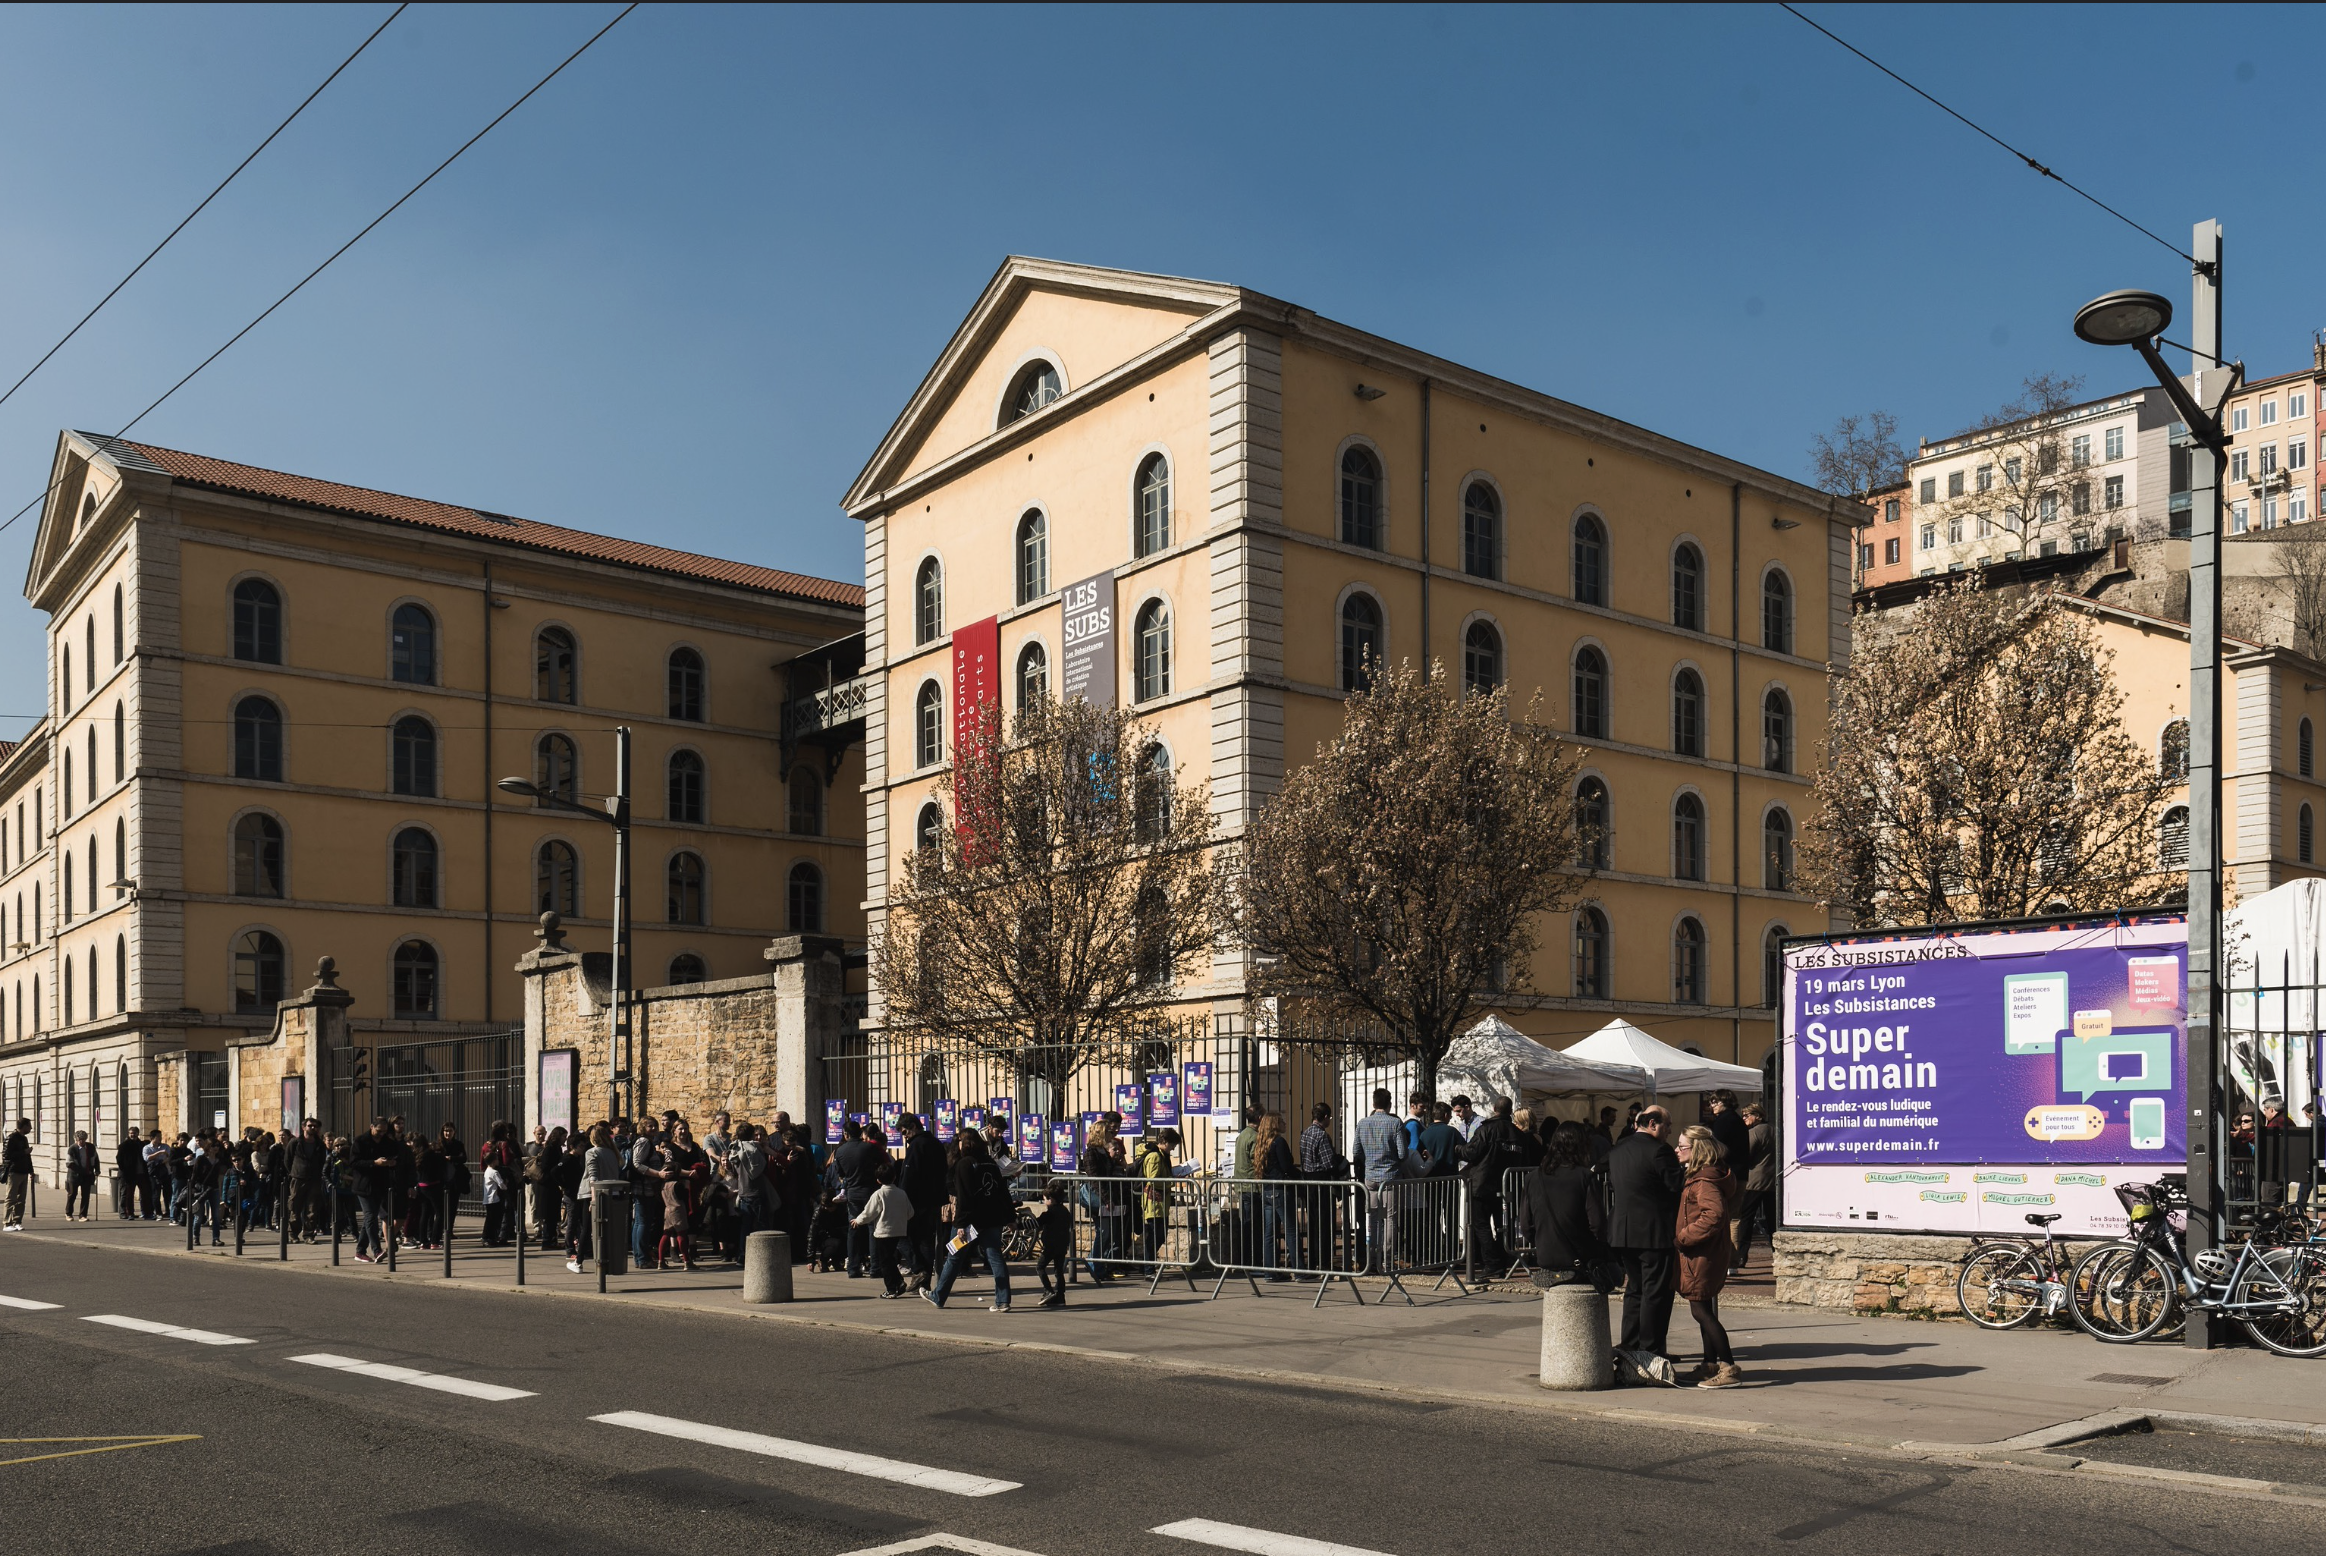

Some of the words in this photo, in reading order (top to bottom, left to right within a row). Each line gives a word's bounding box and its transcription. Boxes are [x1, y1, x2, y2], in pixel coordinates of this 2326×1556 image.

[1065, 580, 1098, 613] LES
[1065, 605, 1110, 643] SUBS
[1795, 955, 1826, 969] LES
[1831, 945, 1968, 967] SUBSISTANCES
[2134, 970, 2154, 978] Datas
[1804, 978, 1823, 994] 19
[1827, 979, 1865, 993] mars
[1870, 975, 1906, 993] Lyon
[2013, 986, 2051, 994] Conférences
[2135, 987, 2159, 995] Médias
[1804, 1001, 1830, 1016] Les
[1834, 996, 1936, 1014] Subsistances
[2135, 995, 2171, 1003] Jeux-vidéo
[2013, 1003, 2037, 1011] Ateliers
[2013, 1012, 2032, 1020] Expos
[2081, 1022, 2104, 1030] Gratuit
[1806, 1022, 1910, 1062] Super
[1806, 1053, 1937, 1092] demain
[1806, 1101, 1819, 1112] Le
[1821, 1100, 1888, 1112] rendez-vous
[1890, 1098, 1932, 1113] ludique
[1806, 1117, 1818, 1128] et
[1819, 1115, 1860, 1128] familial
[1863, 1116, 1877, 1128] du
[1879, 1114, 1939, 1129] numérique
[1806, 1138, 1940, 1154] www.superdemain.fr
[1870, 1173, 1903, 1181] ALEXANDER
[2077, 1176, 2100, 1184] MICHEL
